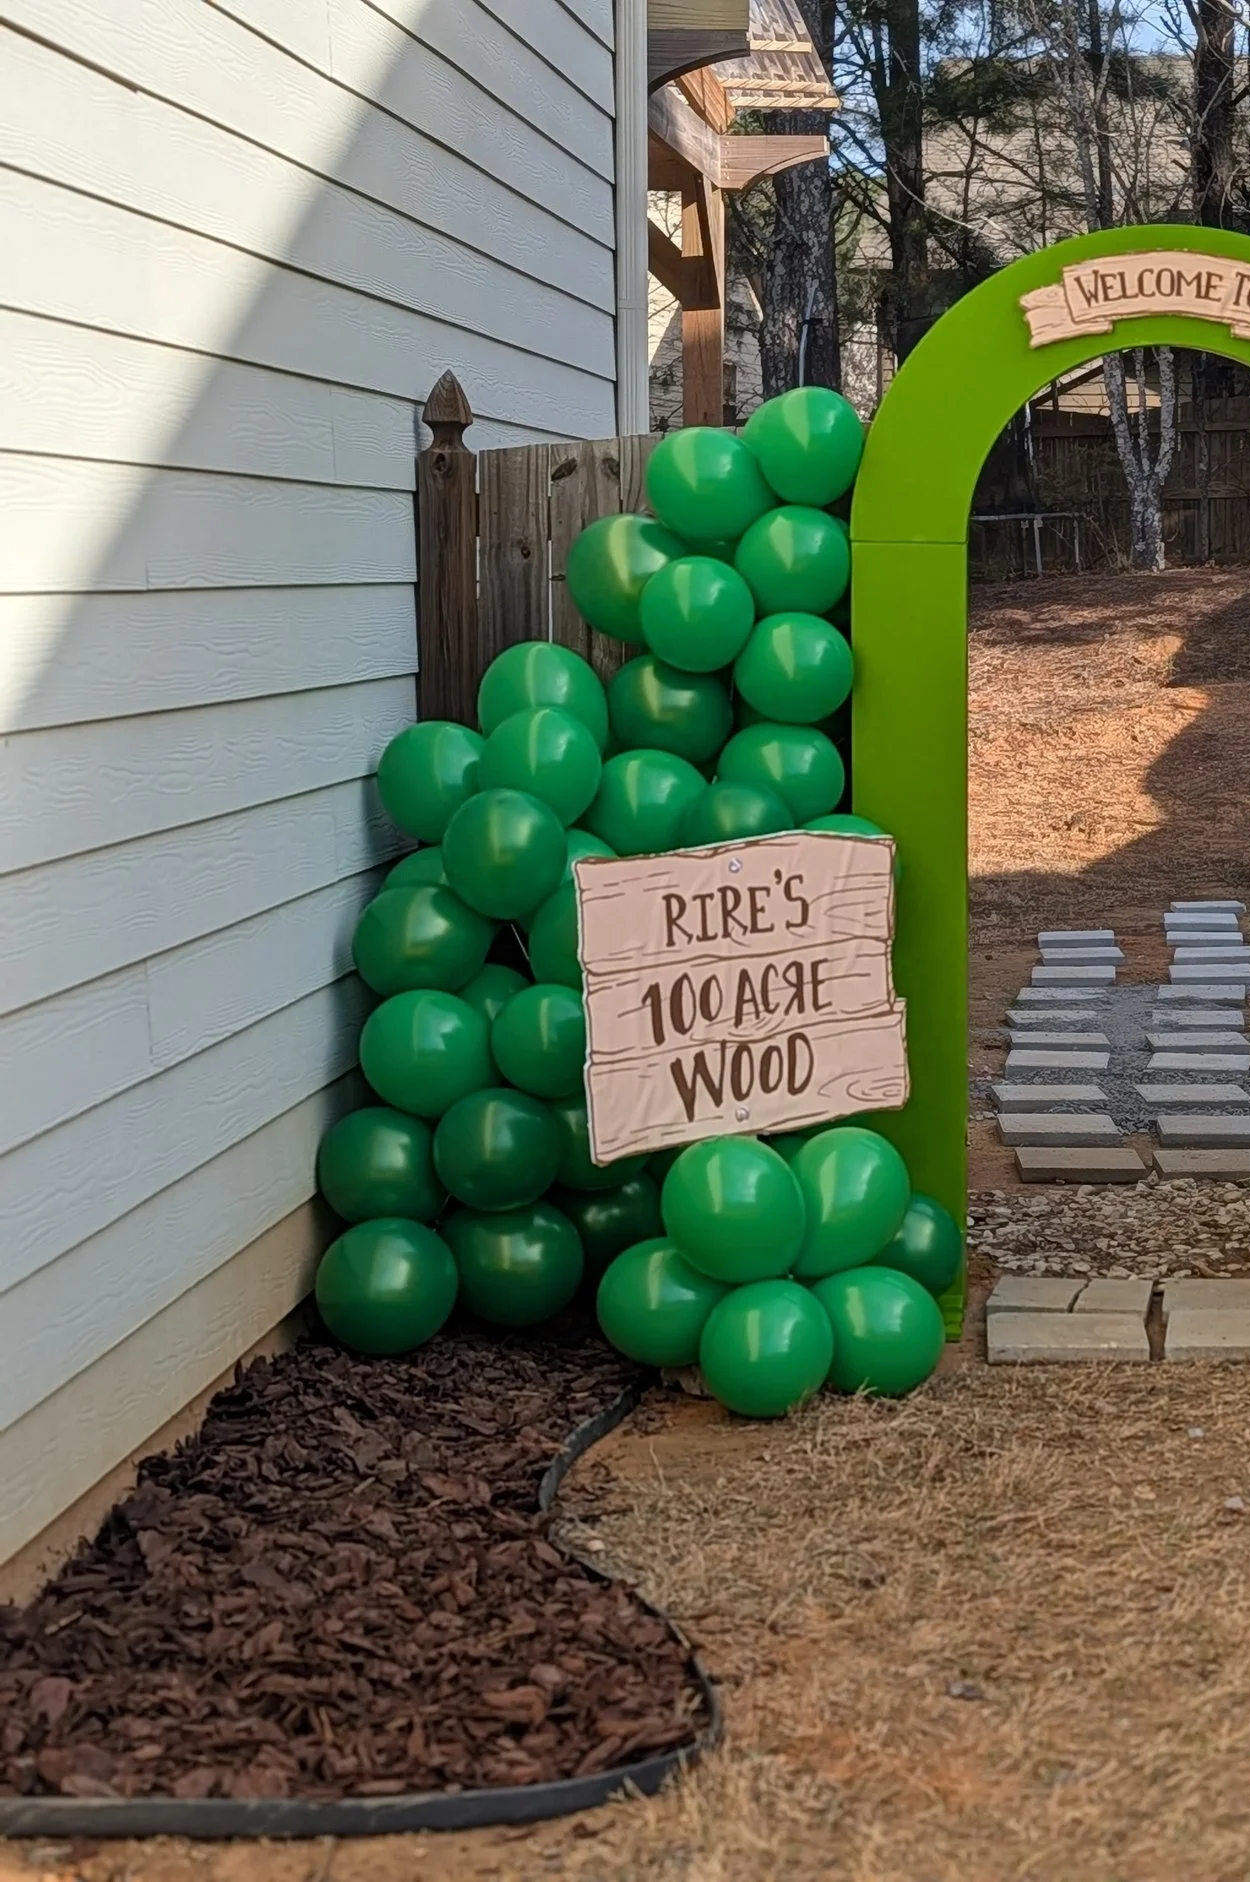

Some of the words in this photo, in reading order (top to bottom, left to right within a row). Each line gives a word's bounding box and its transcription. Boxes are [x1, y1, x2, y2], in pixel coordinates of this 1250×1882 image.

[1074, 268, 1221, 308] WELCOME
[662, 868, 810, 947] RIRE'S
[641, 972, 723, 1046] 100
[670, 1031, 815, 1123] WOOD
